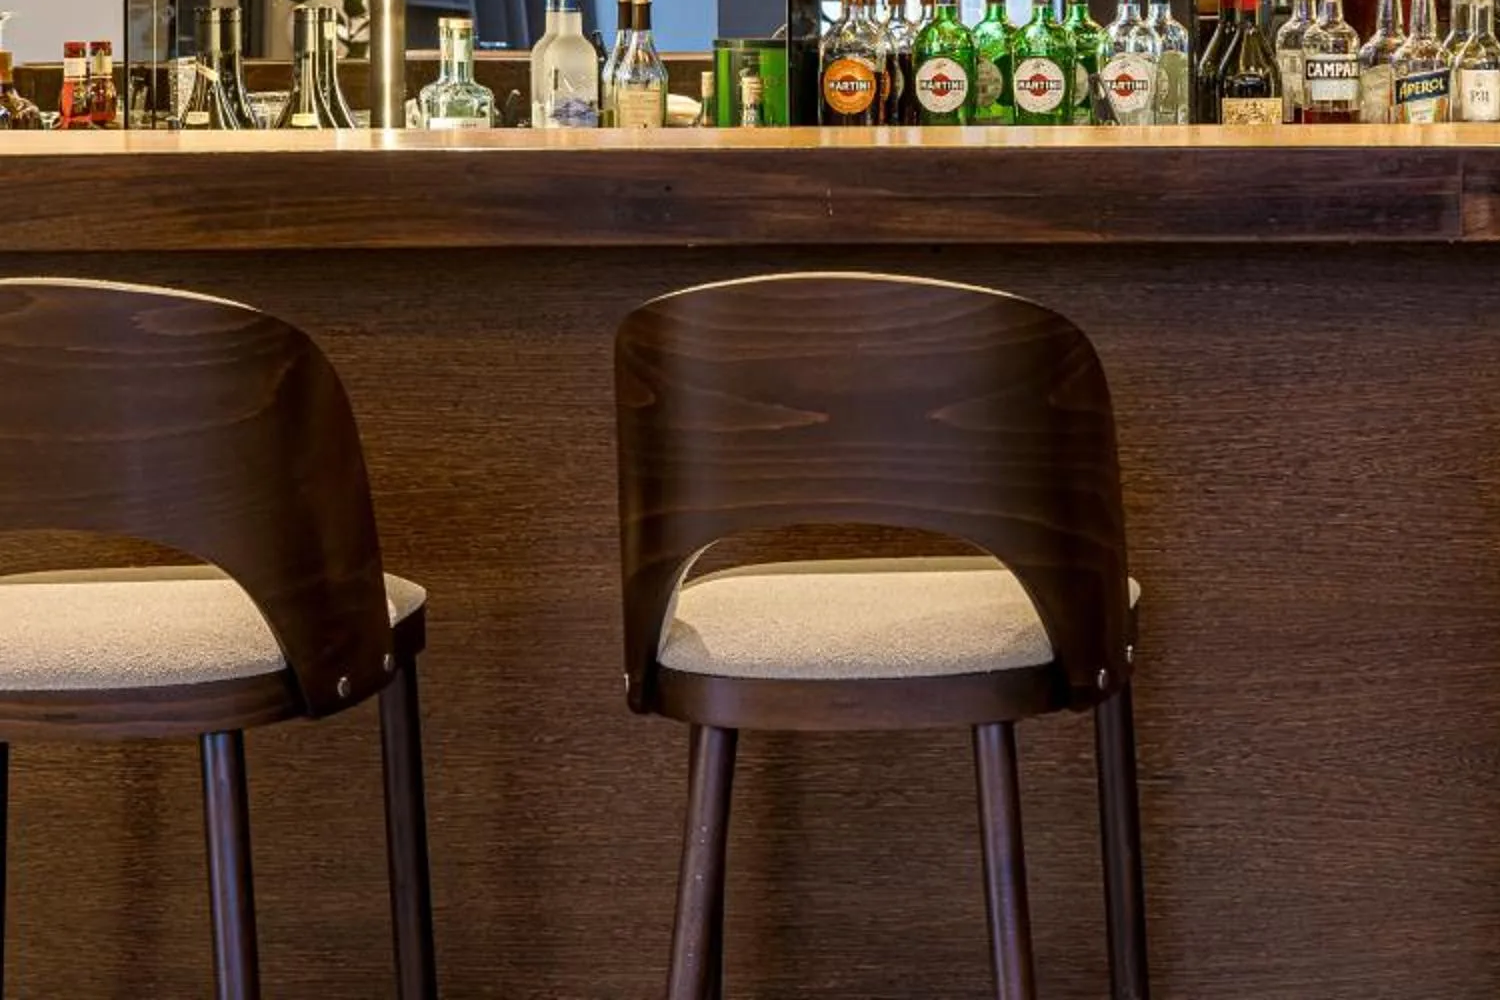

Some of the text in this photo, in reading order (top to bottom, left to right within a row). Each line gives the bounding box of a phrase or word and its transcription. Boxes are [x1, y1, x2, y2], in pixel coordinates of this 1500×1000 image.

[829, 80, 871, 91] MARTINI
[921, 80, 964, 91] MARTINI
[1018, 80, 1062, 90] MARTINI
[1400, 78, 1445, 98] APEROL
